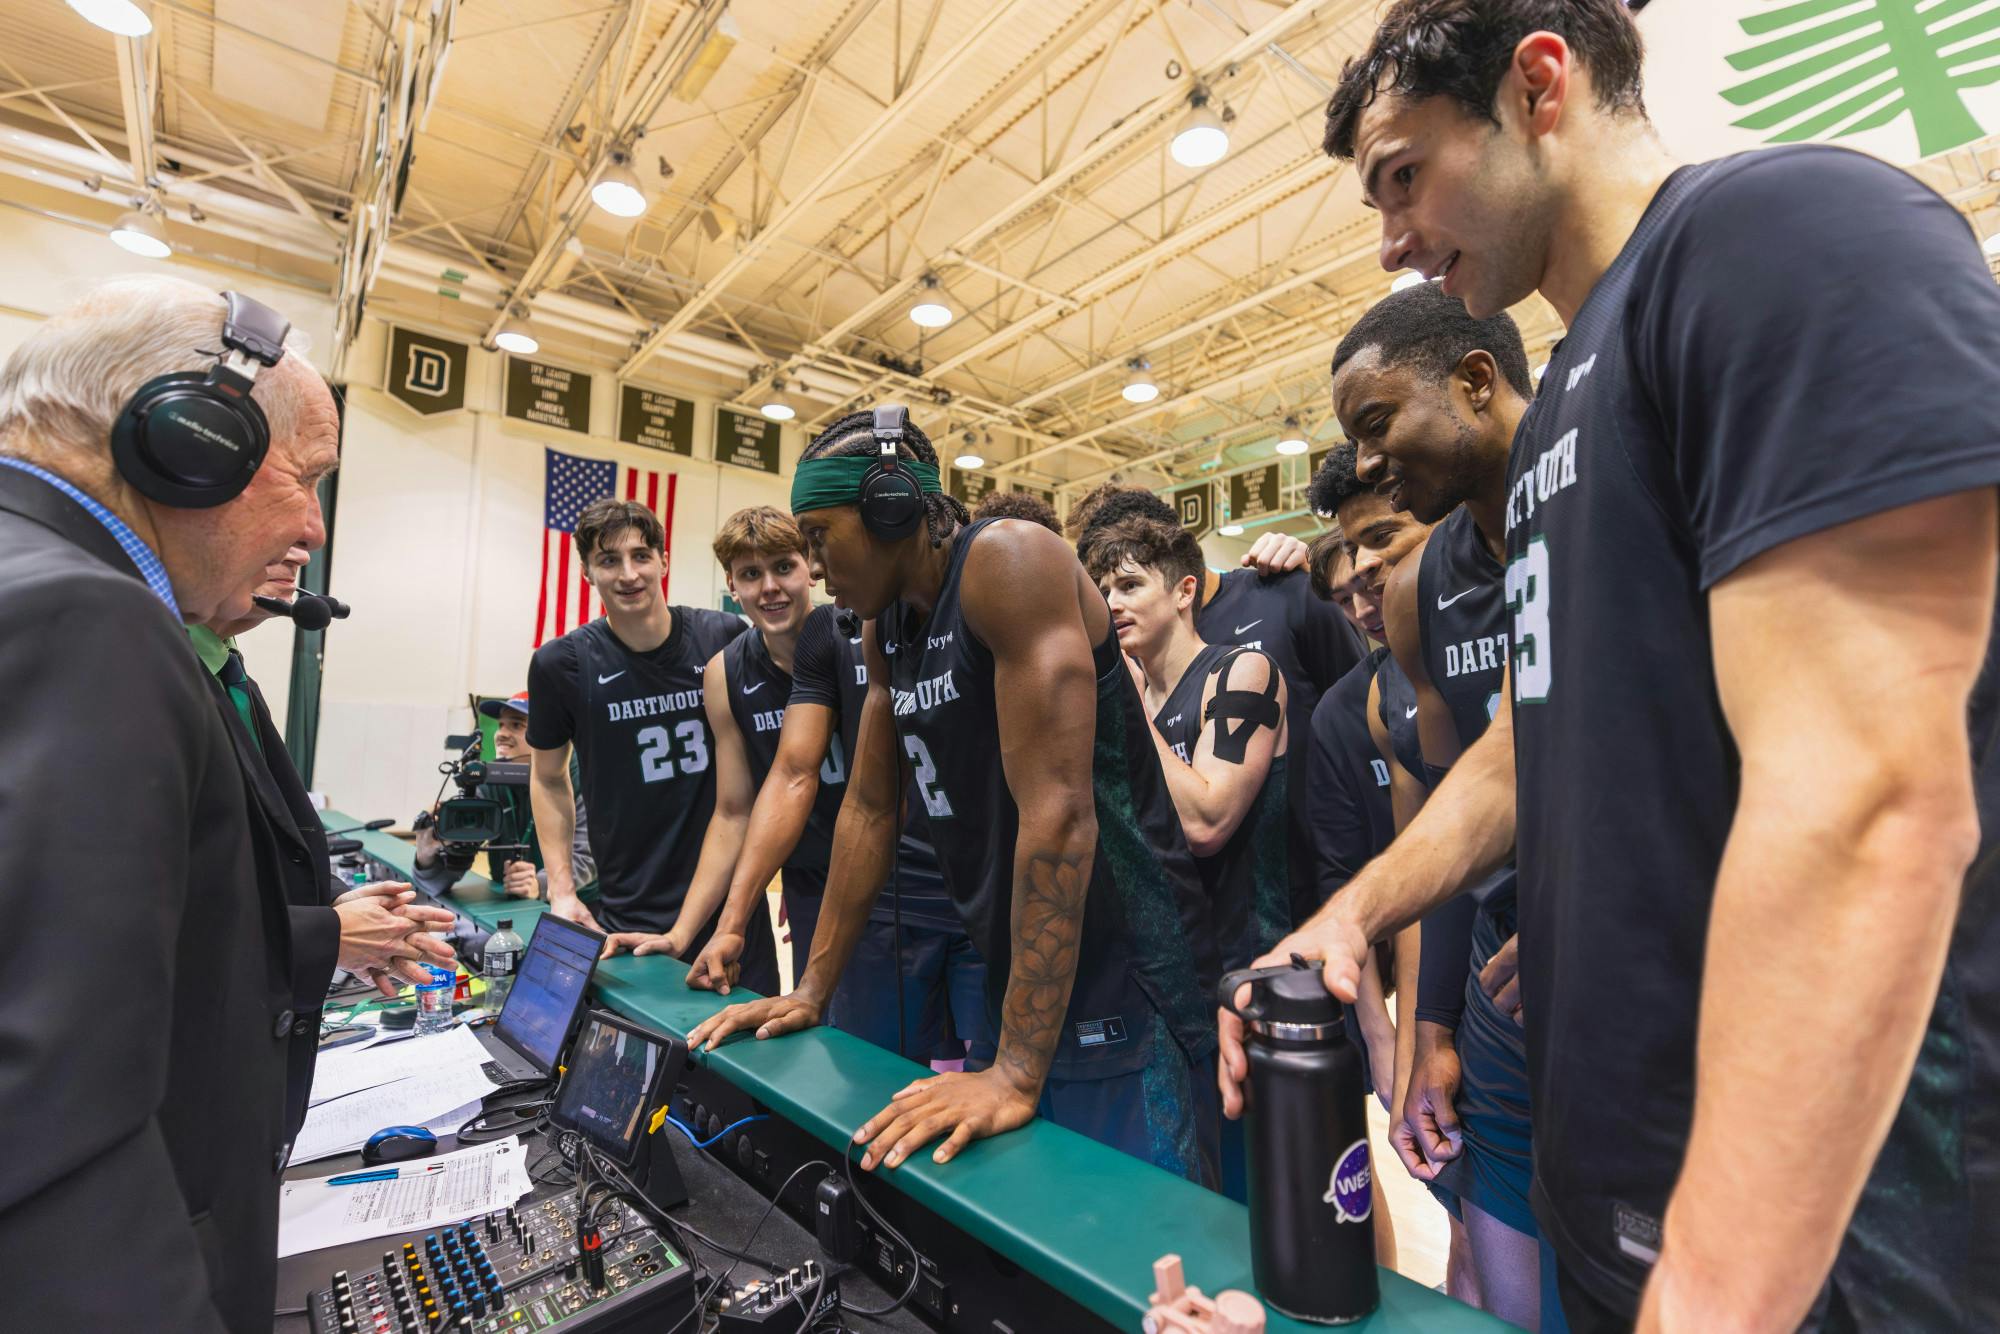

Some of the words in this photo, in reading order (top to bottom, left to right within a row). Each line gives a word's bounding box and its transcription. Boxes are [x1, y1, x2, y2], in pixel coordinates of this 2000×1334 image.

[405, 344, 451, 397] D
[526, 409, 571, 428] BASKETBALL
[636, 719, 710, 784] 23
[903, 733, 954, 817] 2
